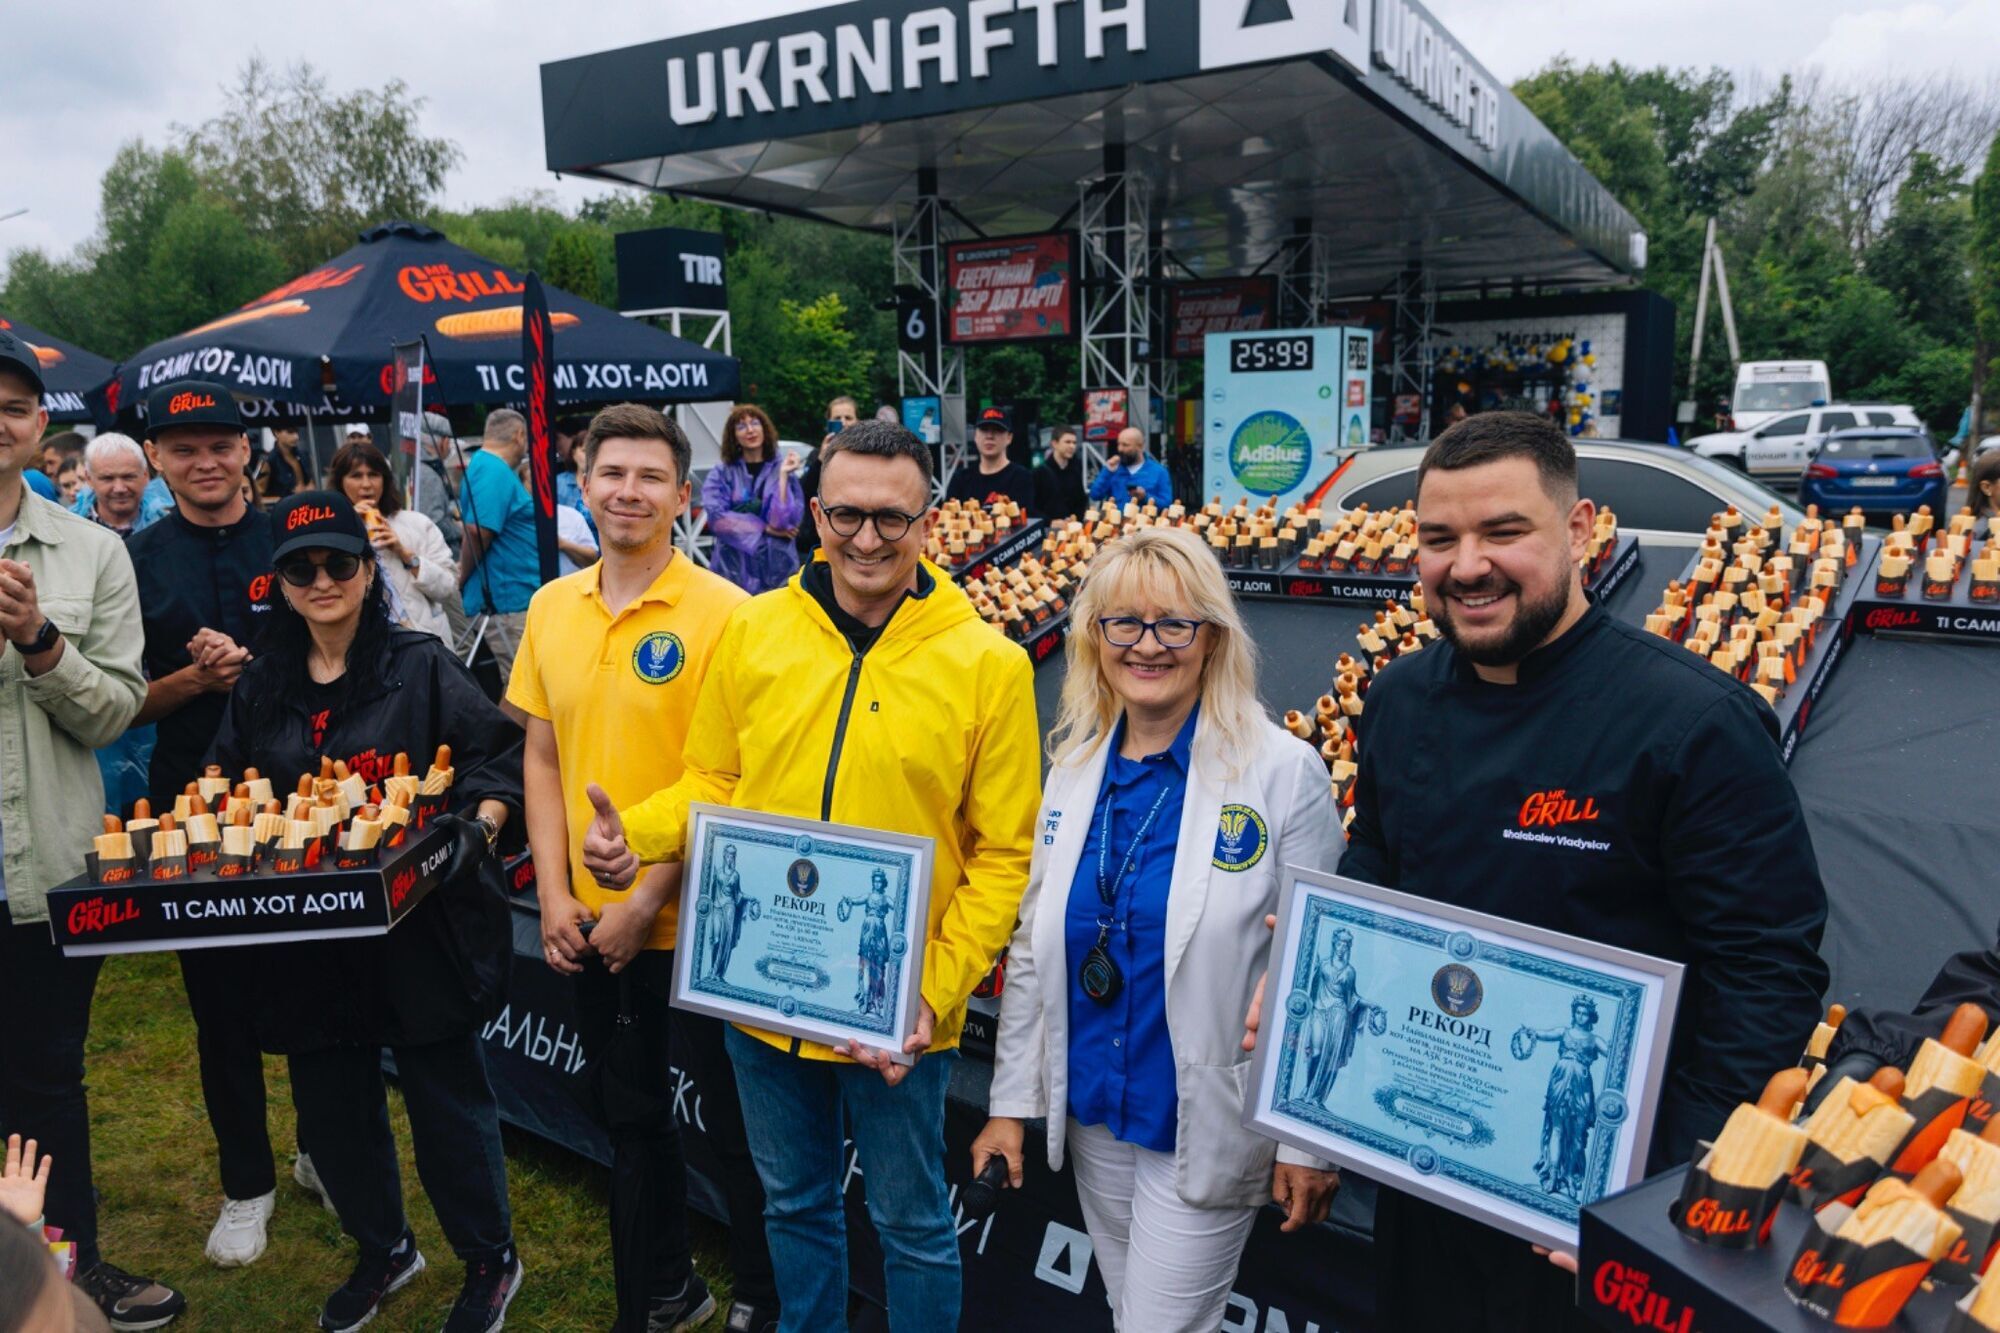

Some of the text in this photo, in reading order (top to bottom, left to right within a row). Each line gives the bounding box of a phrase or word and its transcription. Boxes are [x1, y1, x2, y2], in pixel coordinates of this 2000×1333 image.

[667, 0, 1147, 126] UKRNAFTA
[678, 252, 722, 285] TIR
[397, 266, 525, 303] GRILL
[905, 308, 925, 339] 6
[151, 351, 191, 384] САМІ
[1236, 341, 1309, 369] 25:99
[476, 362, 708, 391] ТІ СМІ ХОТ-ДОГИ
[169, 394, 215, 414] GRILL
[1238, 444, 1303, 463] AdBlue
[286, 506, 336, 530] GRILL
[1243, 580, 1272, 592] ДОГИ
[1343, 586, 1373, 598] САМІ
[1375, 588, 1397, 599] ХОТ
[1866, 609, 1920, 629] GRILL
[1518, 792, 1600, 828] GRILL
[1556, 835, 1611, 851] Vladyslav
[514, 862, 536, 889] GRI
[67, 898, 140, 935] GRILL
[161, 891, 365, 920] ТІ САМІ ХОТ ДОГИ
[773, 894, 826, 917] РЕКОРД
[1407, 1005, 1493, 1049] РЕКОРД
[1593, 1260, 1696, 1333] GRILL
